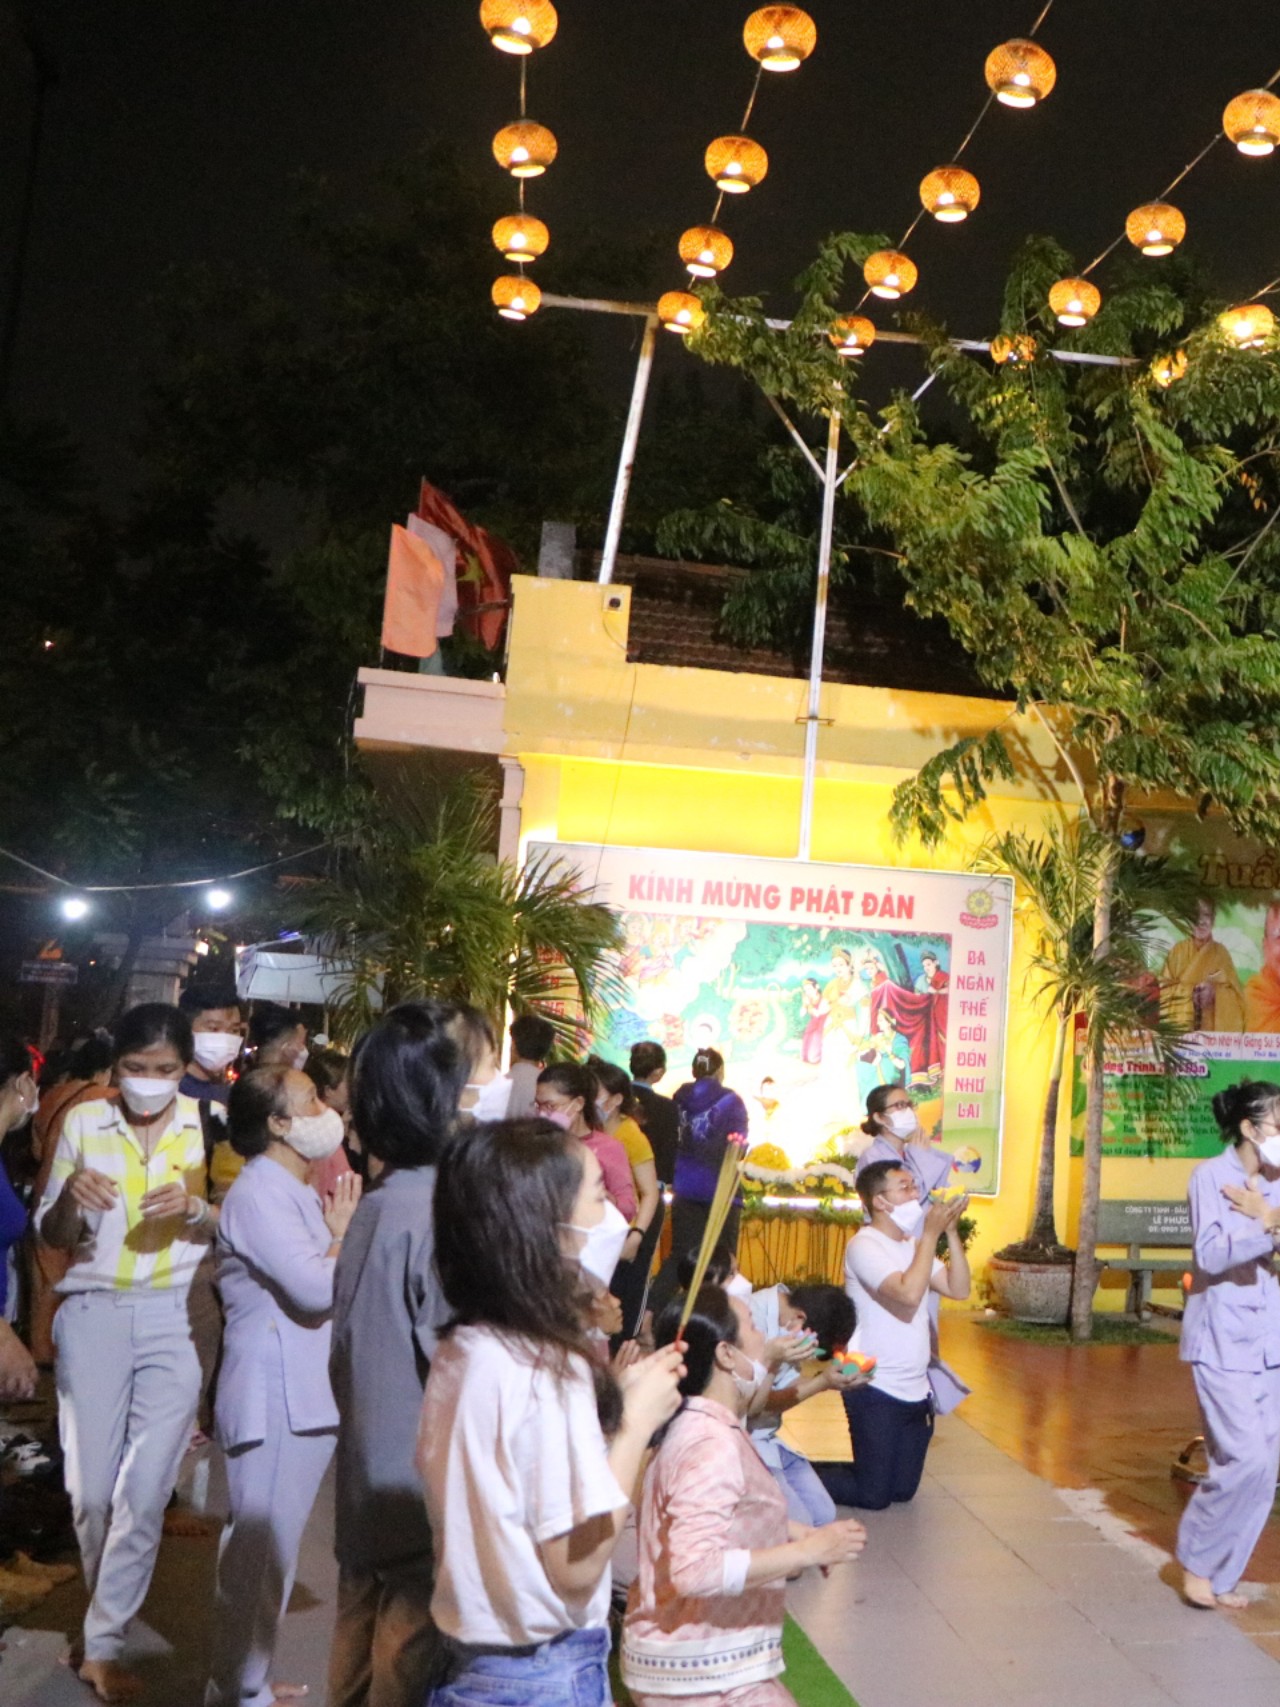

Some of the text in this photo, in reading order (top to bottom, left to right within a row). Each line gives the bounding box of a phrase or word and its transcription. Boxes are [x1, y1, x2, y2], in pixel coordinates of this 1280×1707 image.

[628, 870, 693, 903] KÍNH
[790, 884, 854, 921] PHẬT
[861, 887, 915, 919] ĐẢN
[956, 973, 995, 992] NGÀN
[960, 996, 990, 1016] THẾ
[959, 1024, 987, 1042] GIỚI
[957, 1049, 987, 1068] ĐÓN
[955, 1076, 986, 1093] NHƯ
[958, 1103, 980, 1118] LAI
